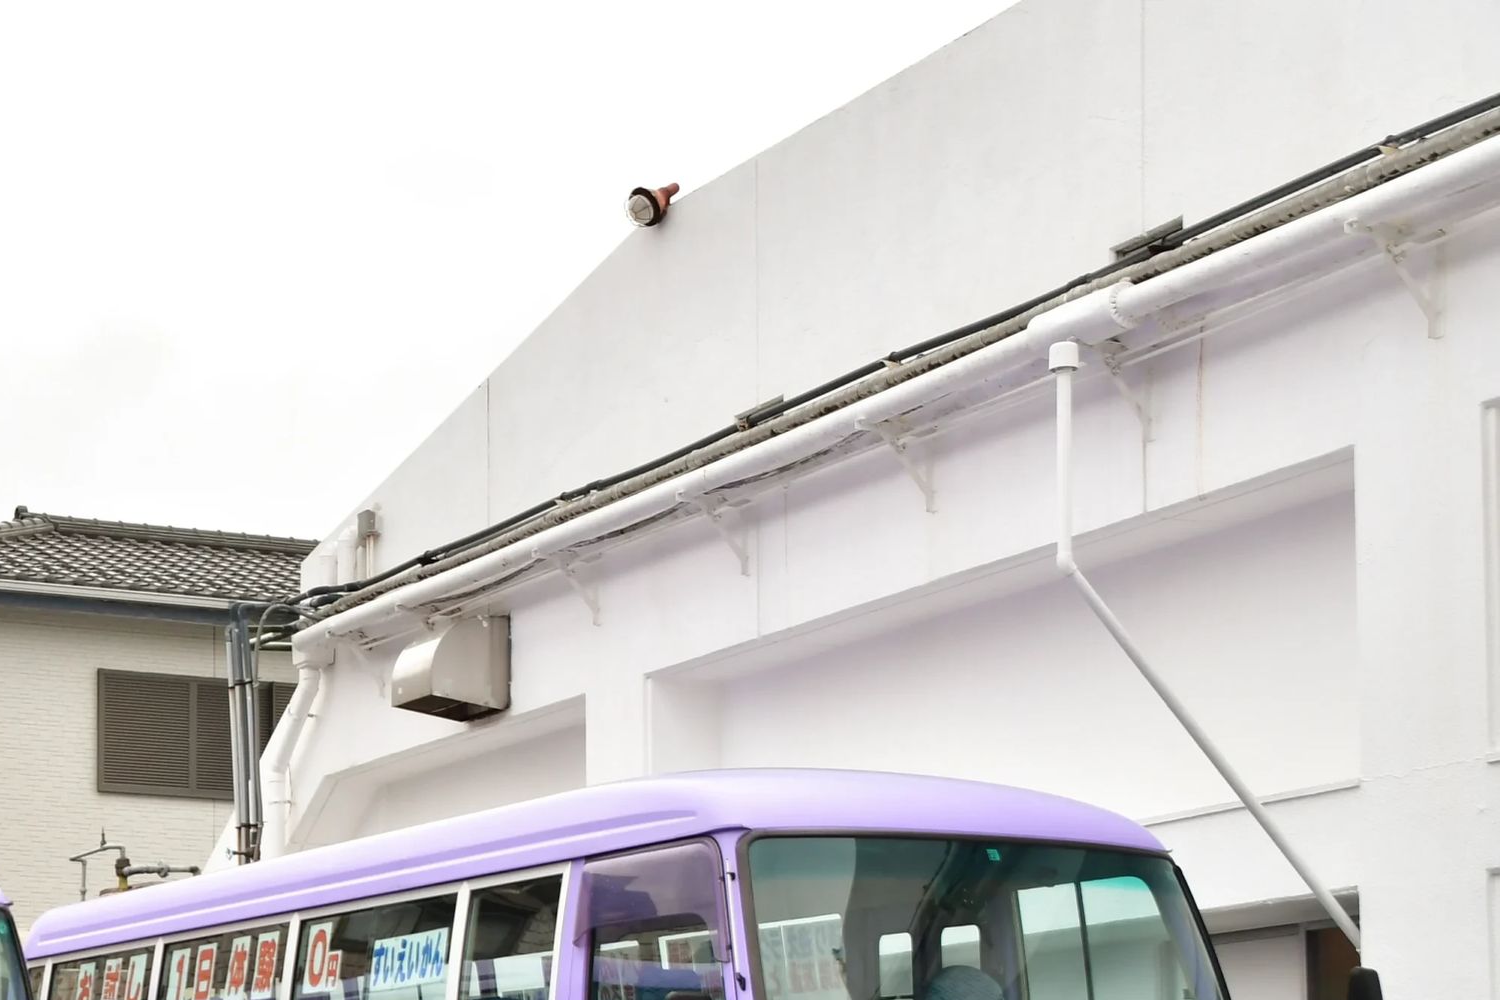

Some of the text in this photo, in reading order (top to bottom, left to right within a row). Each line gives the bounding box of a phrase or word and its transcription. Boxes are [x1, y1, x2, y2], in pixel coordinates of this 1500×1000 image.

[372, 931, 444, 987] すいえいかん
